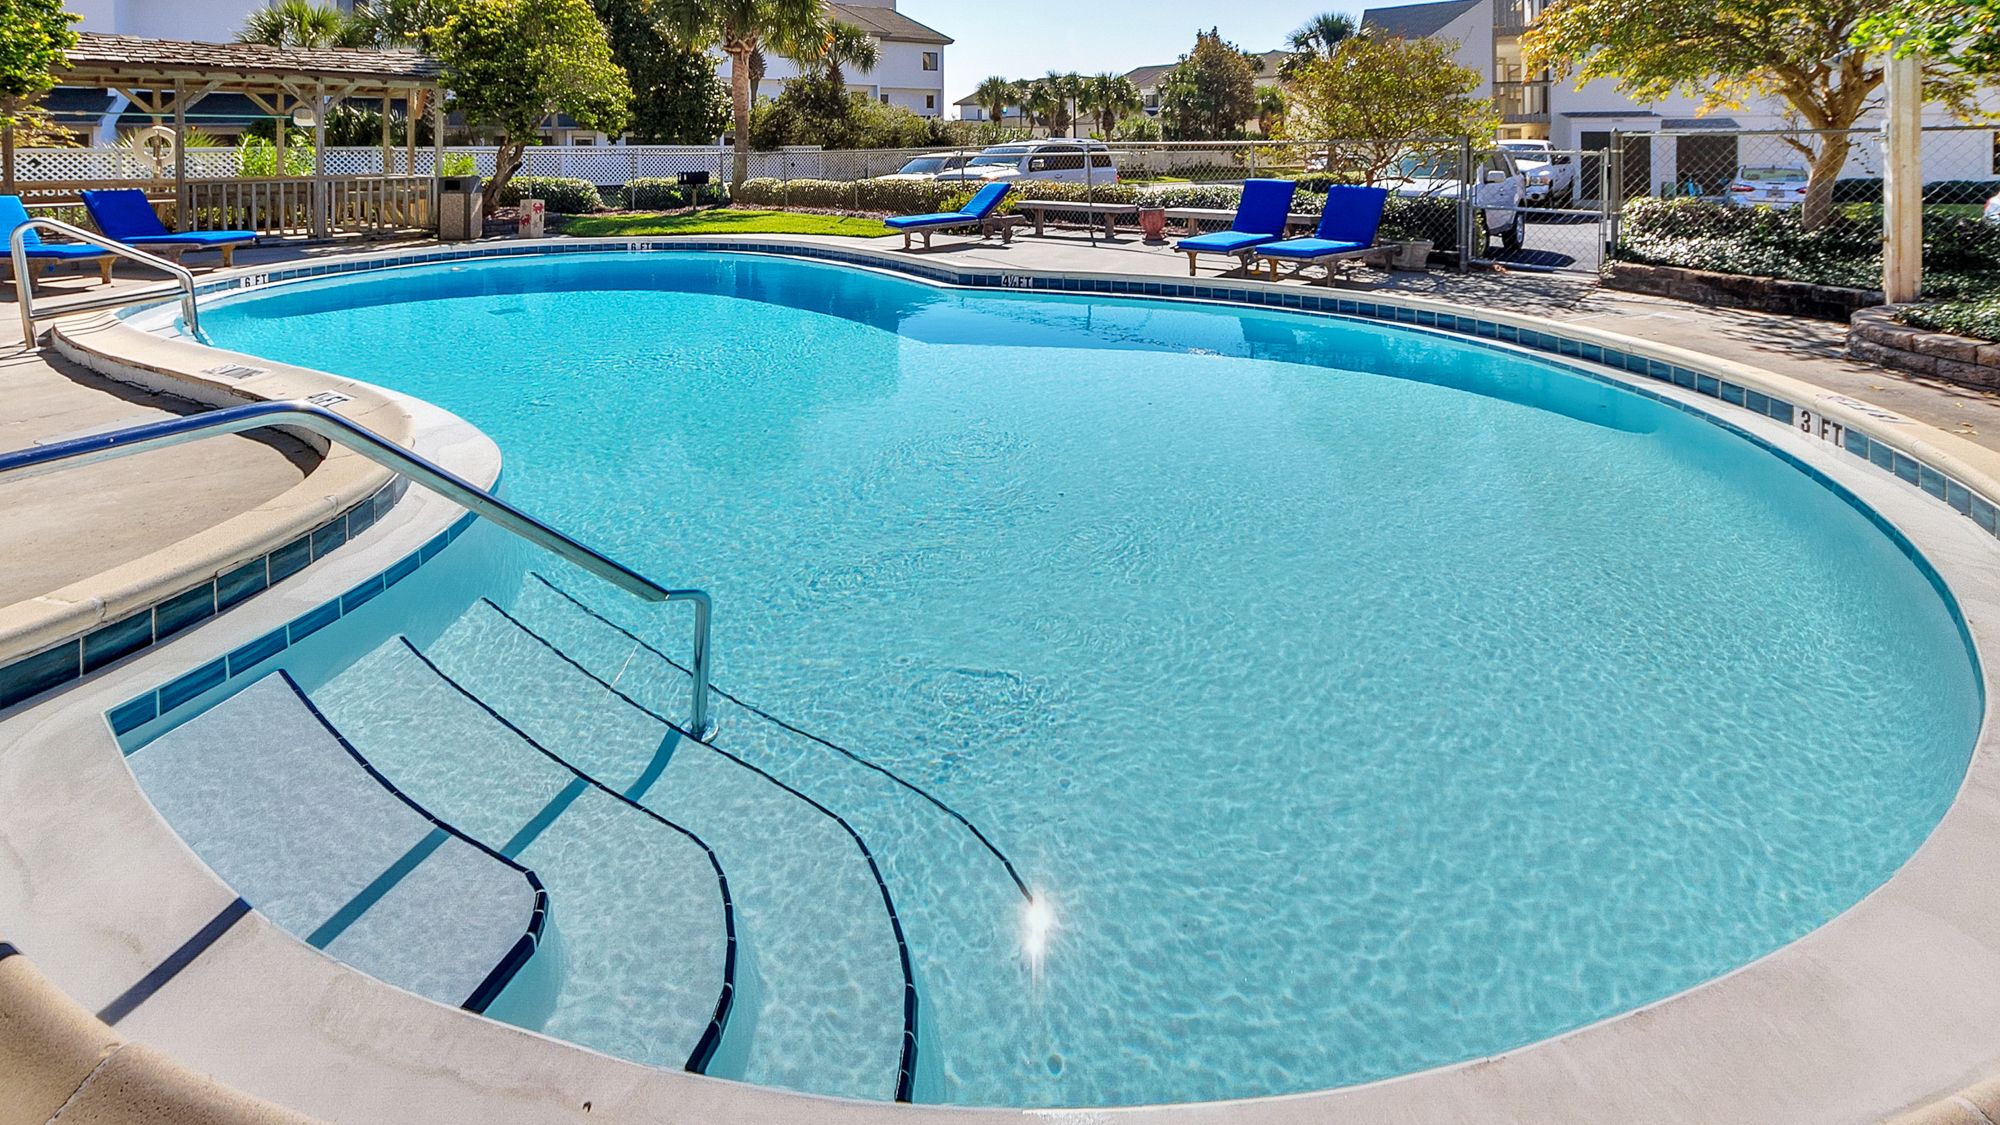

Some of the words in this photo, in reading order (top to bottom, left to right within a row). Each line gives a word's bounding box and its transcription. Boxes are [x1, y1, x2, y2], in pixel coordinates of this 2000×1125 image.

[244, 277, 251, 287] 6
[255, 273, 267, 285] FT
[1801, 410, 1811, 433] 3
